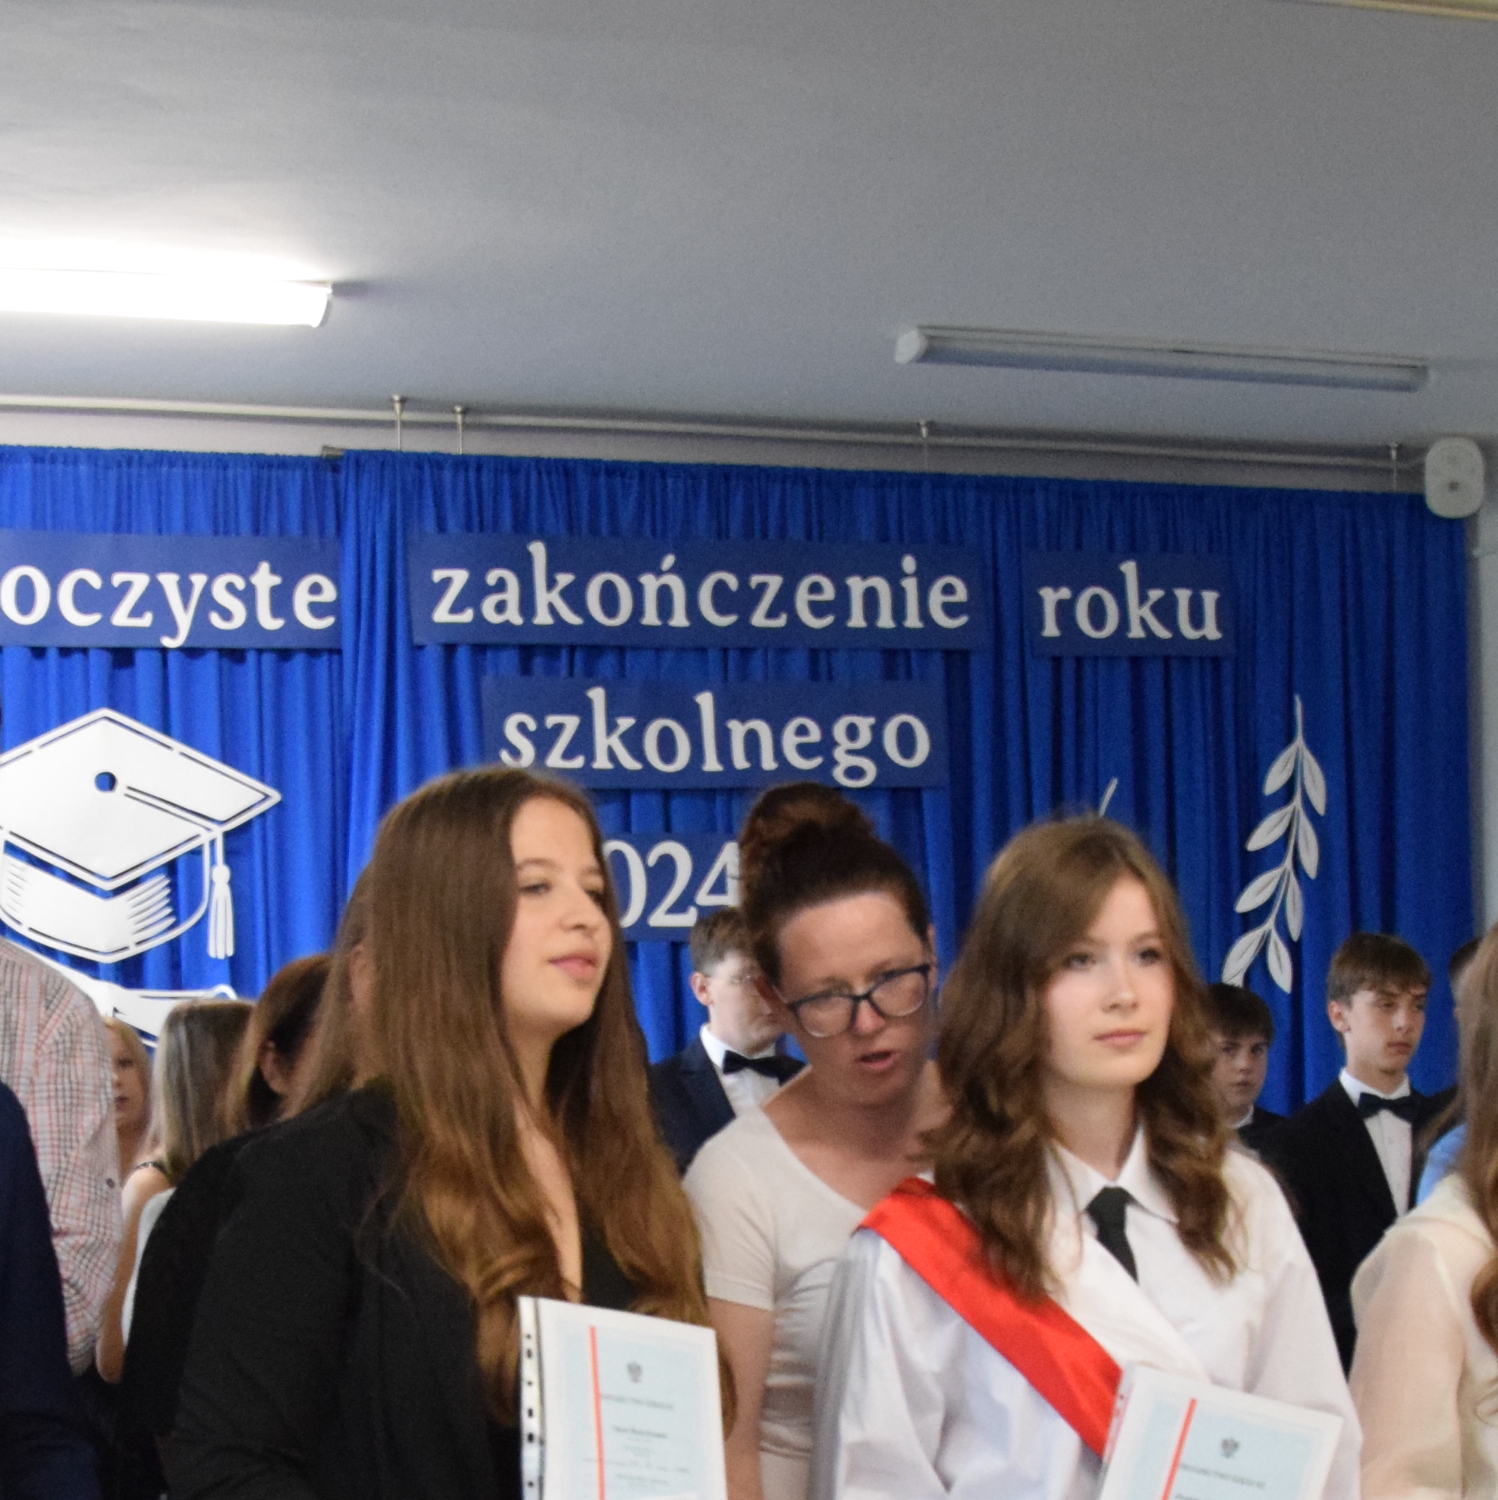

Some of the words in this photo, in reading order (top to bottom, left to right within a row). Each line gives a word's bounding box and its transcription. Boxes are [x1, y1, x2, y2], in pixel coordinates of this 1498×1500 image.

[430, 541, 970, 629] zakończenie
[1038, 560, 1223, 641] roku
[499, 686, 931, 788] szkolnego
